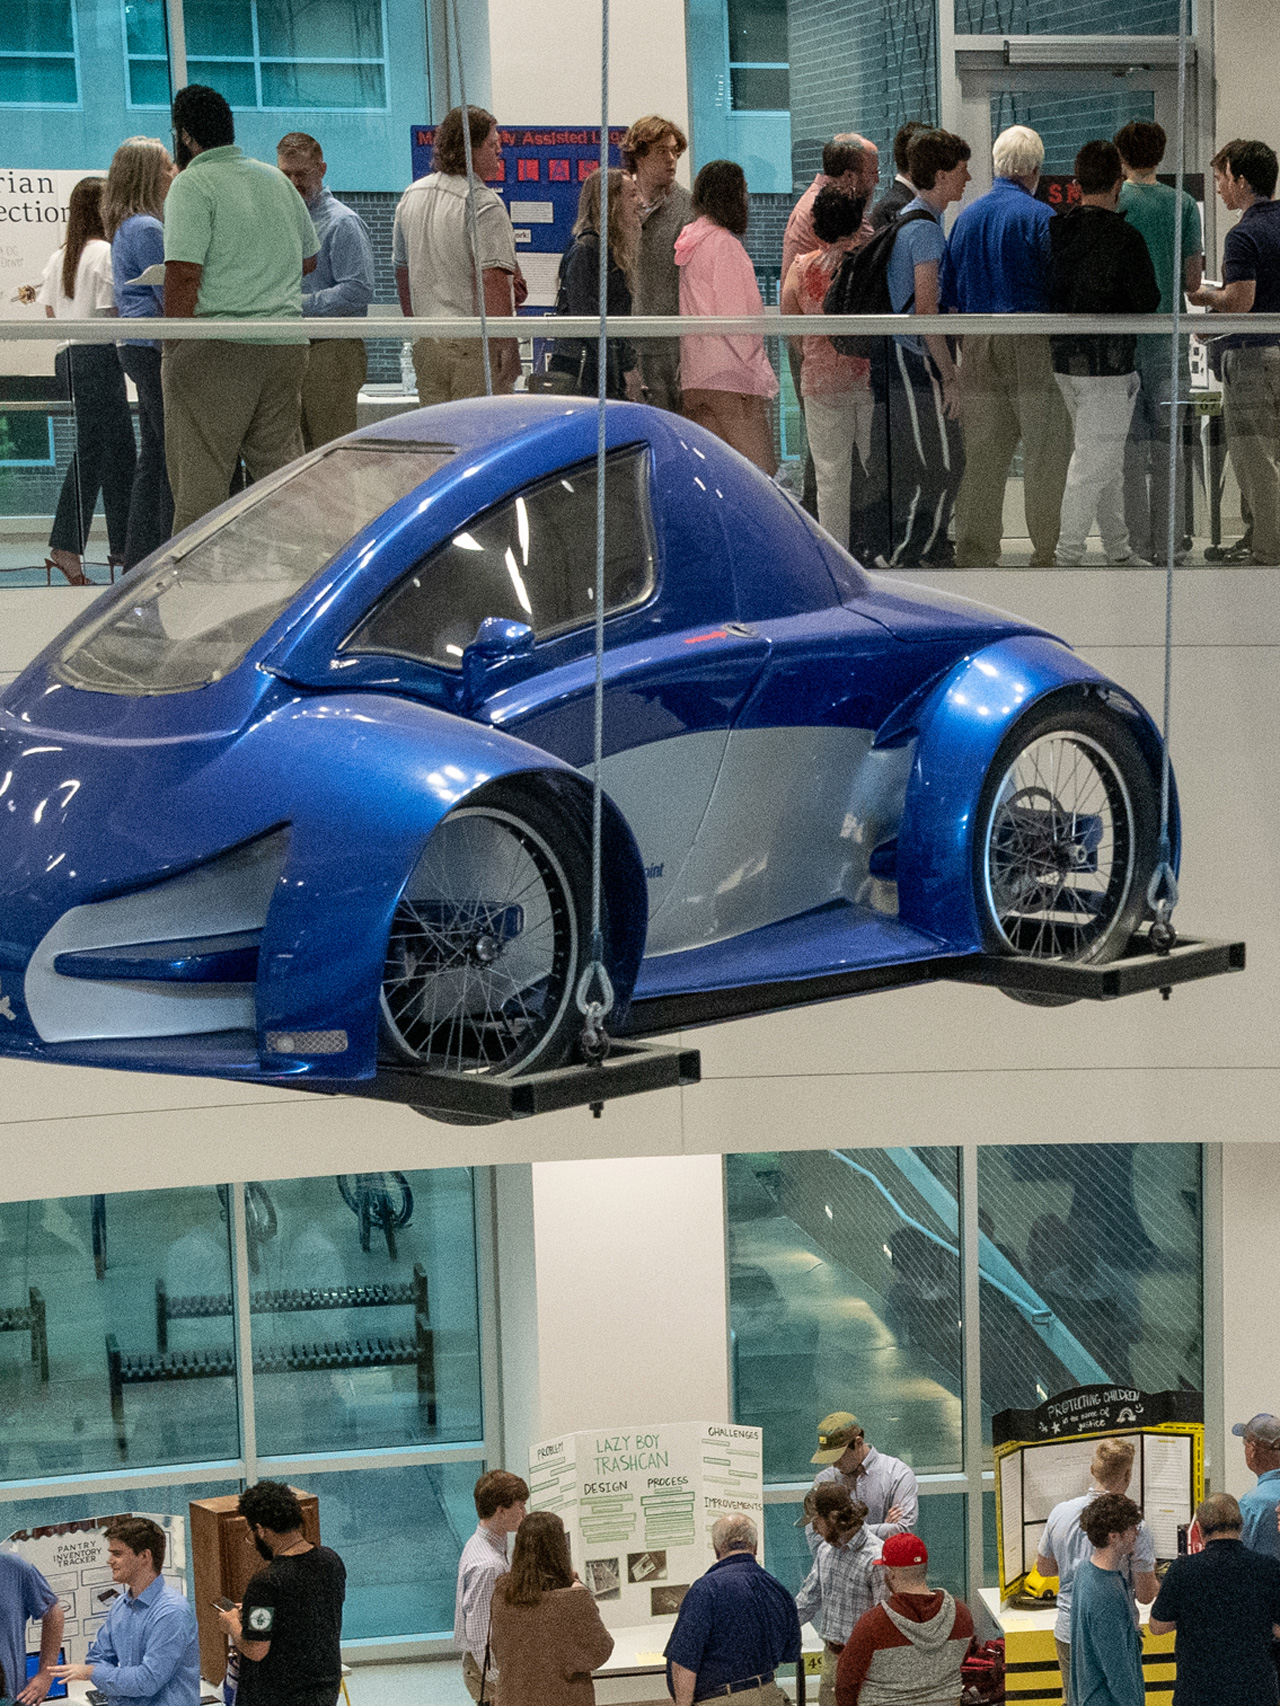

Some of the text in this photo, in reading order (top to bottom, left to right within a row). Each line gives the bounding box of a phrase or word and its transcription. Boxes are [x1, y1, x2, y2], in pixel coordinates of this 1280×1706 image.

[522, 131, 588, 146] Assisted
[1047, 1389, 1140, 1419] PROTECTING CHILDREN
[707, 1426, 759, 1440] CHALLENGES
[596, 1433, 660, 1453] LAZY BOY
[594, 1451, 669, 1476] TRASHCAN
[584, 1480, 629, 1495] DESIGN
[646, 1475, 689, 1488] PROCESS
[704, 1496, 763, 1511] IMPROVEMENTS
[58, 1540, 97, 1553] PANTRY
[53, 1547, 102, 1563] INVENTORY
[58, 1555, 97, 1568] TRACKER
